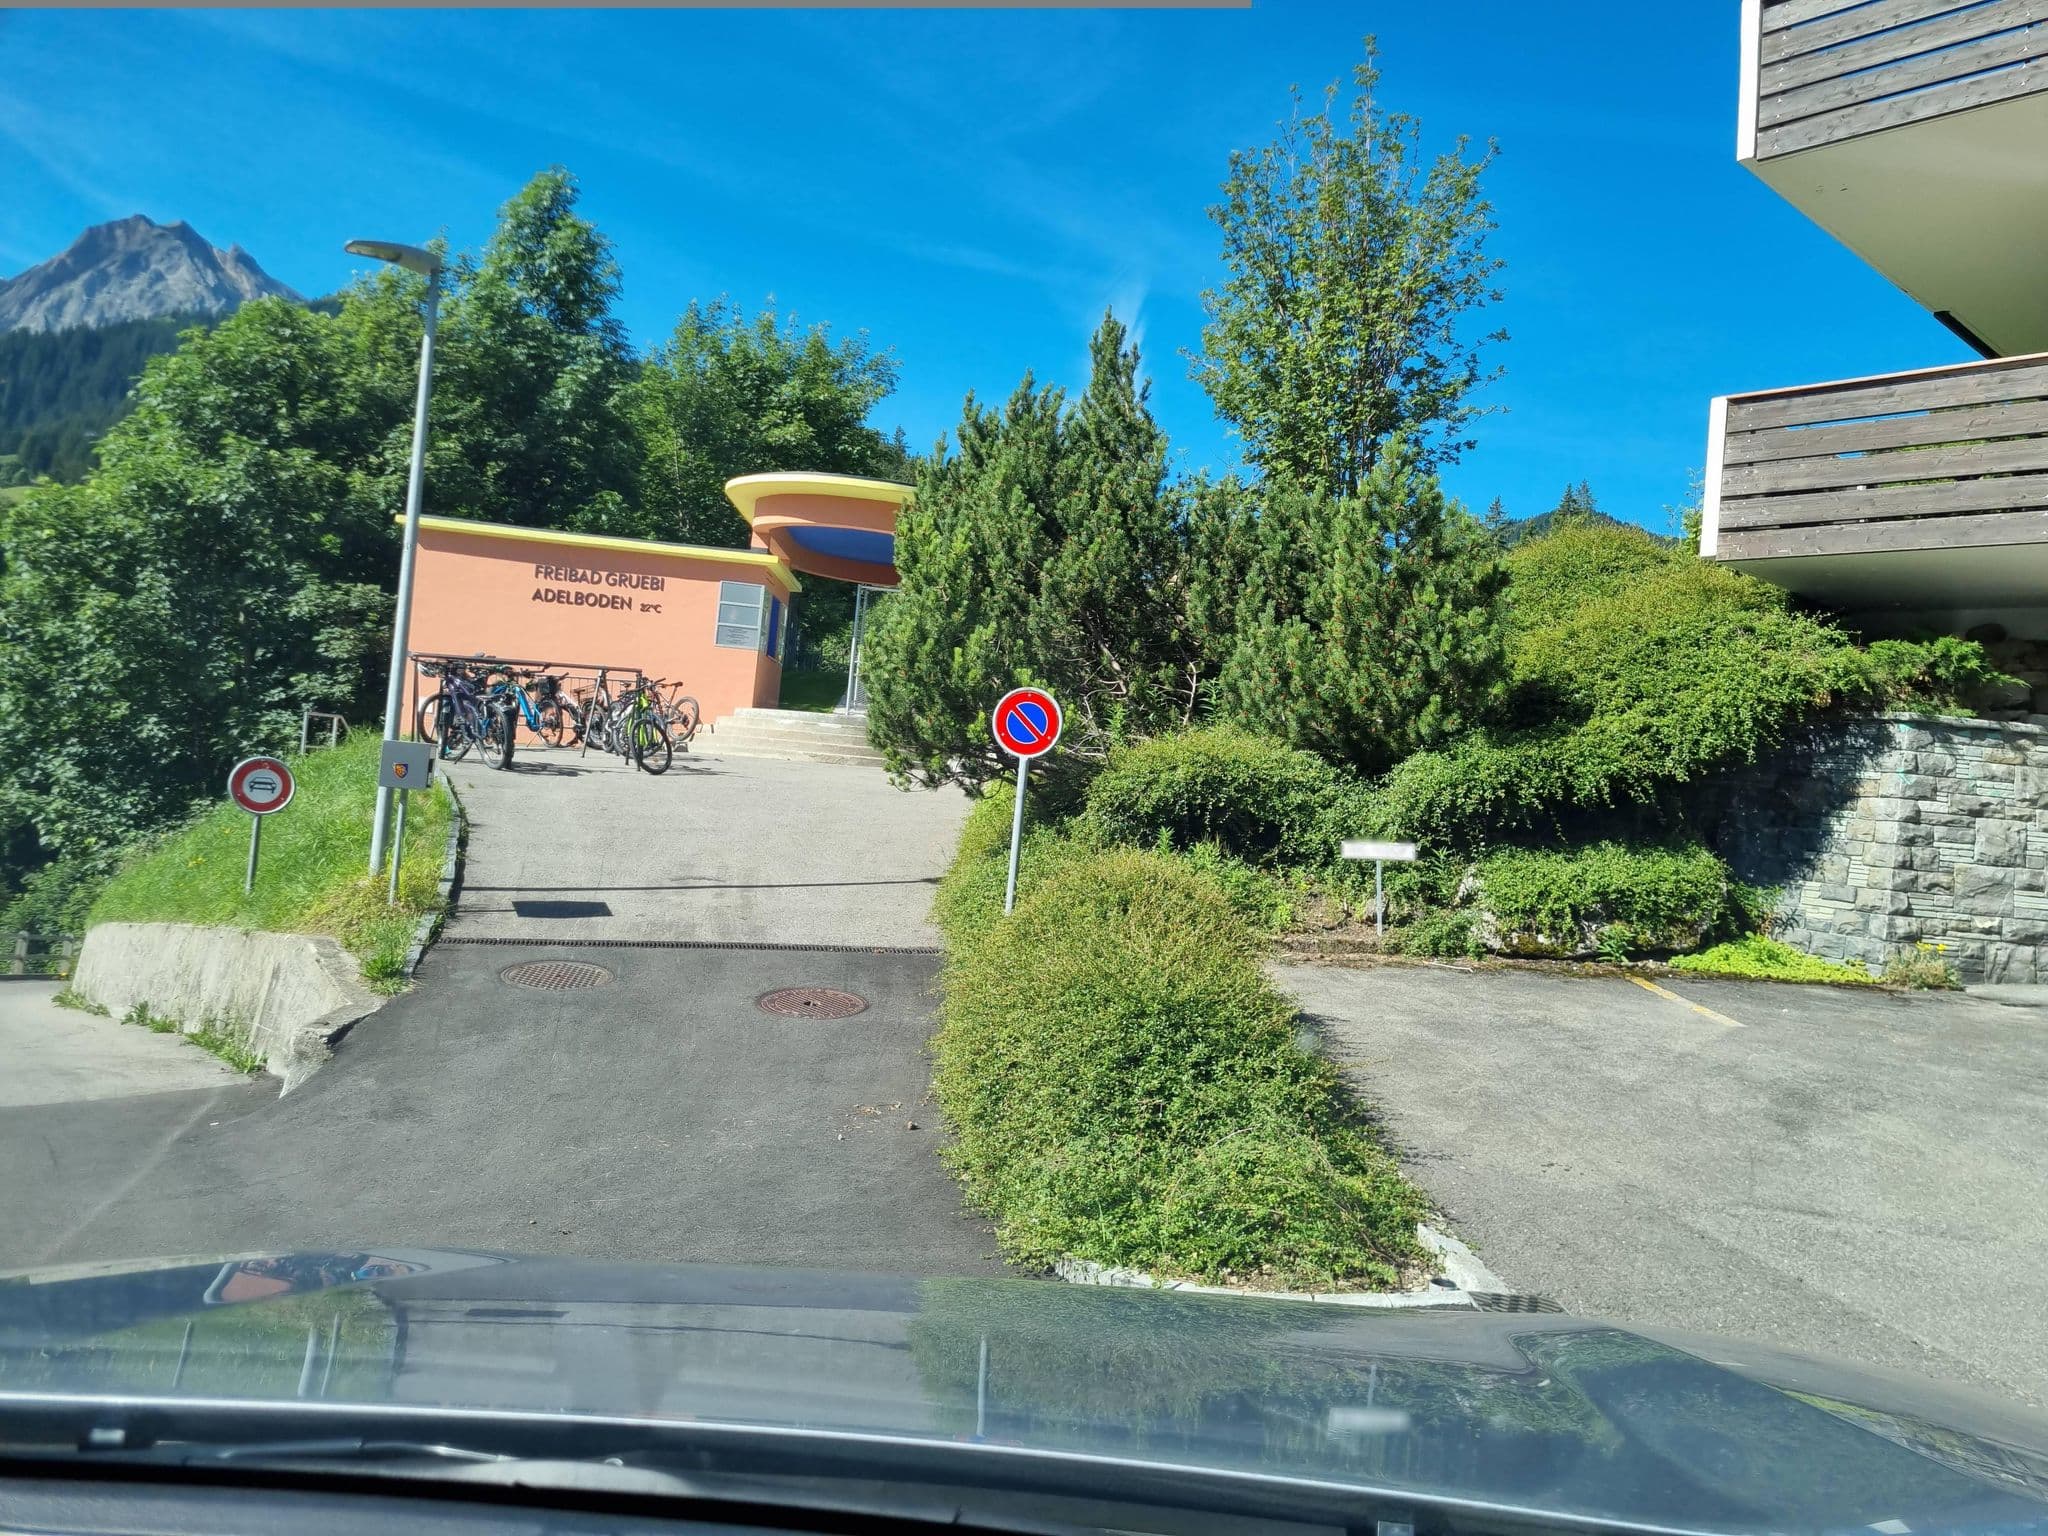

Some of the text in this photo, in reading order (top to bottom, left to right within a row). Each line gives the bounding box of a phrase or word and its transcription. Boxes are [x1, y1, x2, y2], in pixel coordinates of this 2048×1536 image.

[534, 564, 665, 592] FREIBAD GRUEBI
[531, 587, 632, 610] ADELBODEN
